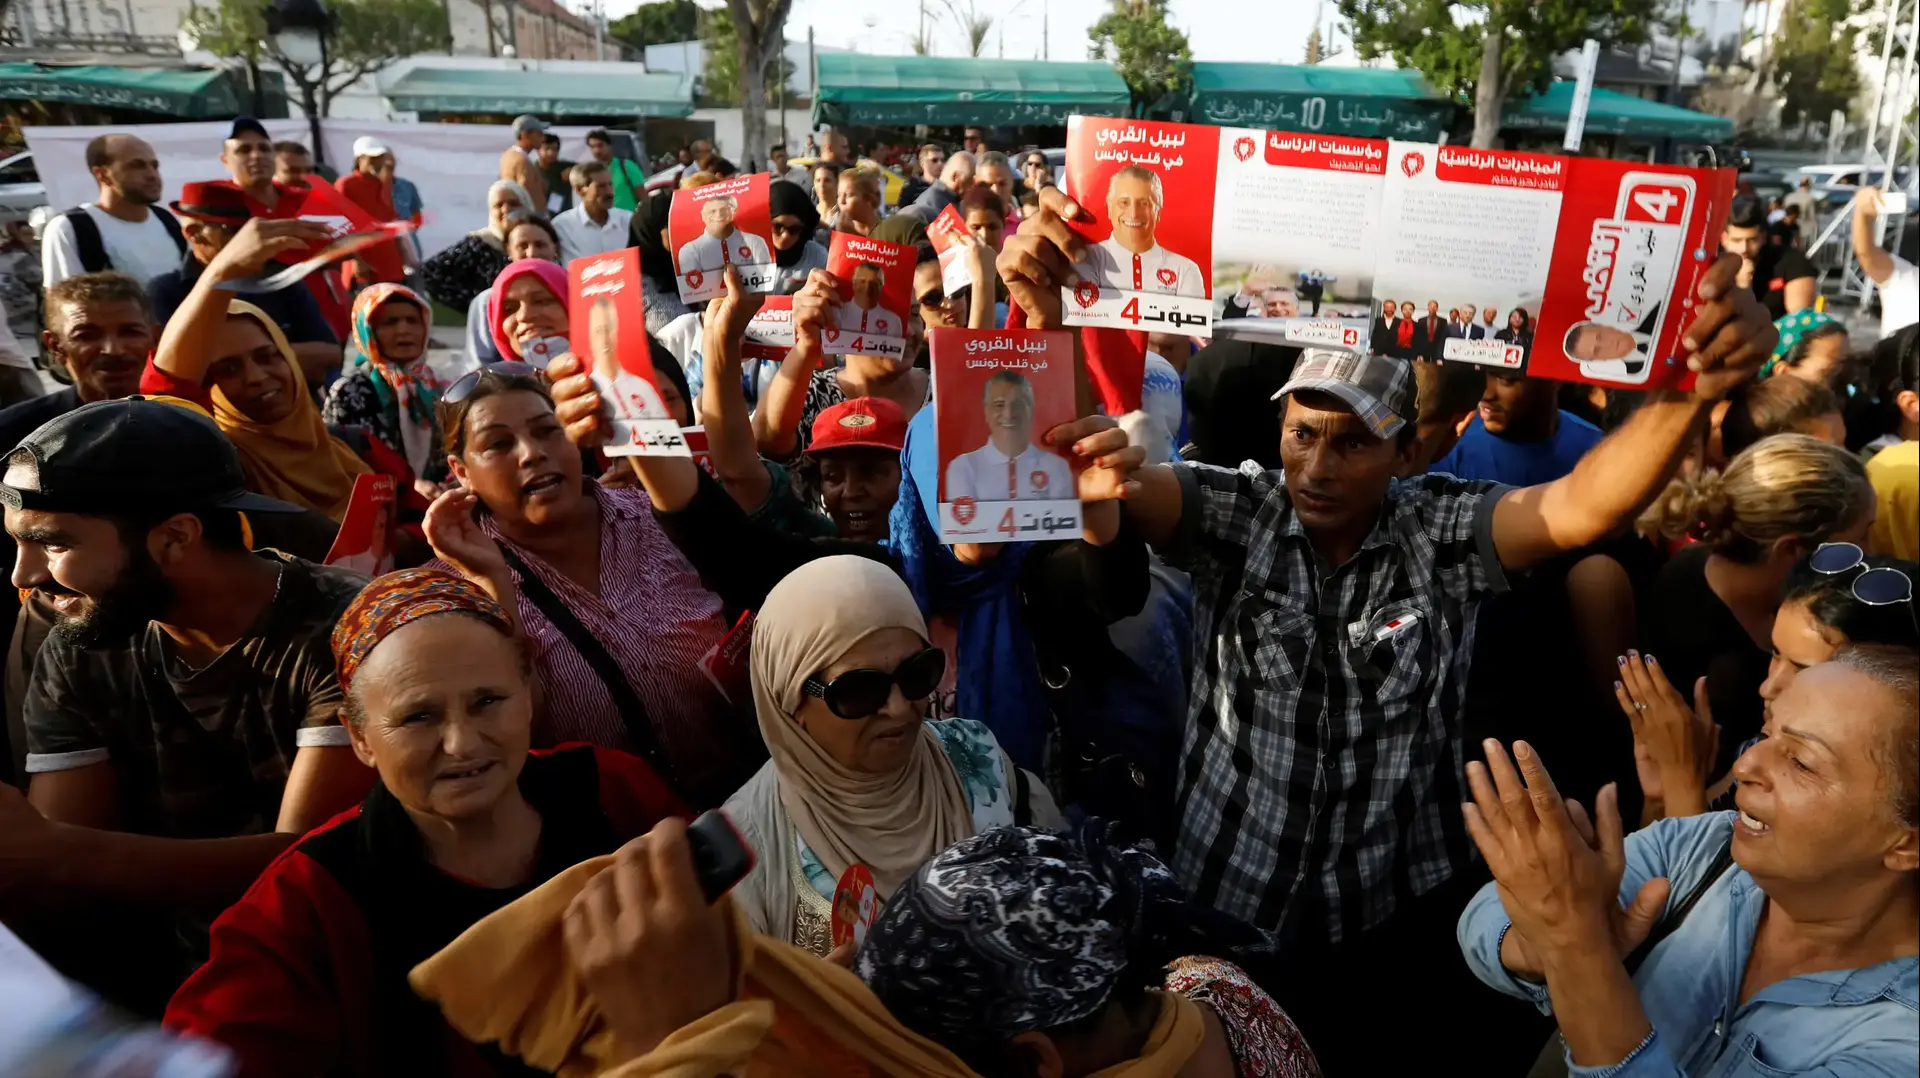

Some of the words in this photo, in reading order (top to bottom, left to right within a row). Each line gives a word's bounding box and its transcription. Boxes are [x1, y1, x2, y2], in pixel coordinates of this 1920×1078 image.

[1096, 126, 1146, 146] القروي
[1150, 130, 1185, 148] نبيل
[1095, 149, 1128, 161] تونس
[1131, 151, 1161, 165] قلب
[1318, 142, 1382, 160] مؤسسات
[1163, 154, 1184, 170] في
[1497, 157, 1561, 175] المبادرات
[1634, 189, 1678, 222] 4
[847, 240, 877, 252] القروي
[879, 245, 899, 256] نبيل
[845, 251, 865, 260] تونس
[866, 256, 884, 264] قلب
[885, 259, 897, 267] في
[1121, 297, 1142, 325] 4
[850, 336, 864, 352] 4
[965, 337, 1013, 354] القروي
[1016, 339, 1048, 354] نبيل
[965, 358, 999, 369] تونس
[1000, 358, 1028, 369] قلب
[1030, 360, 1048, 373] في
[997, 507, 1017, 538] 4
